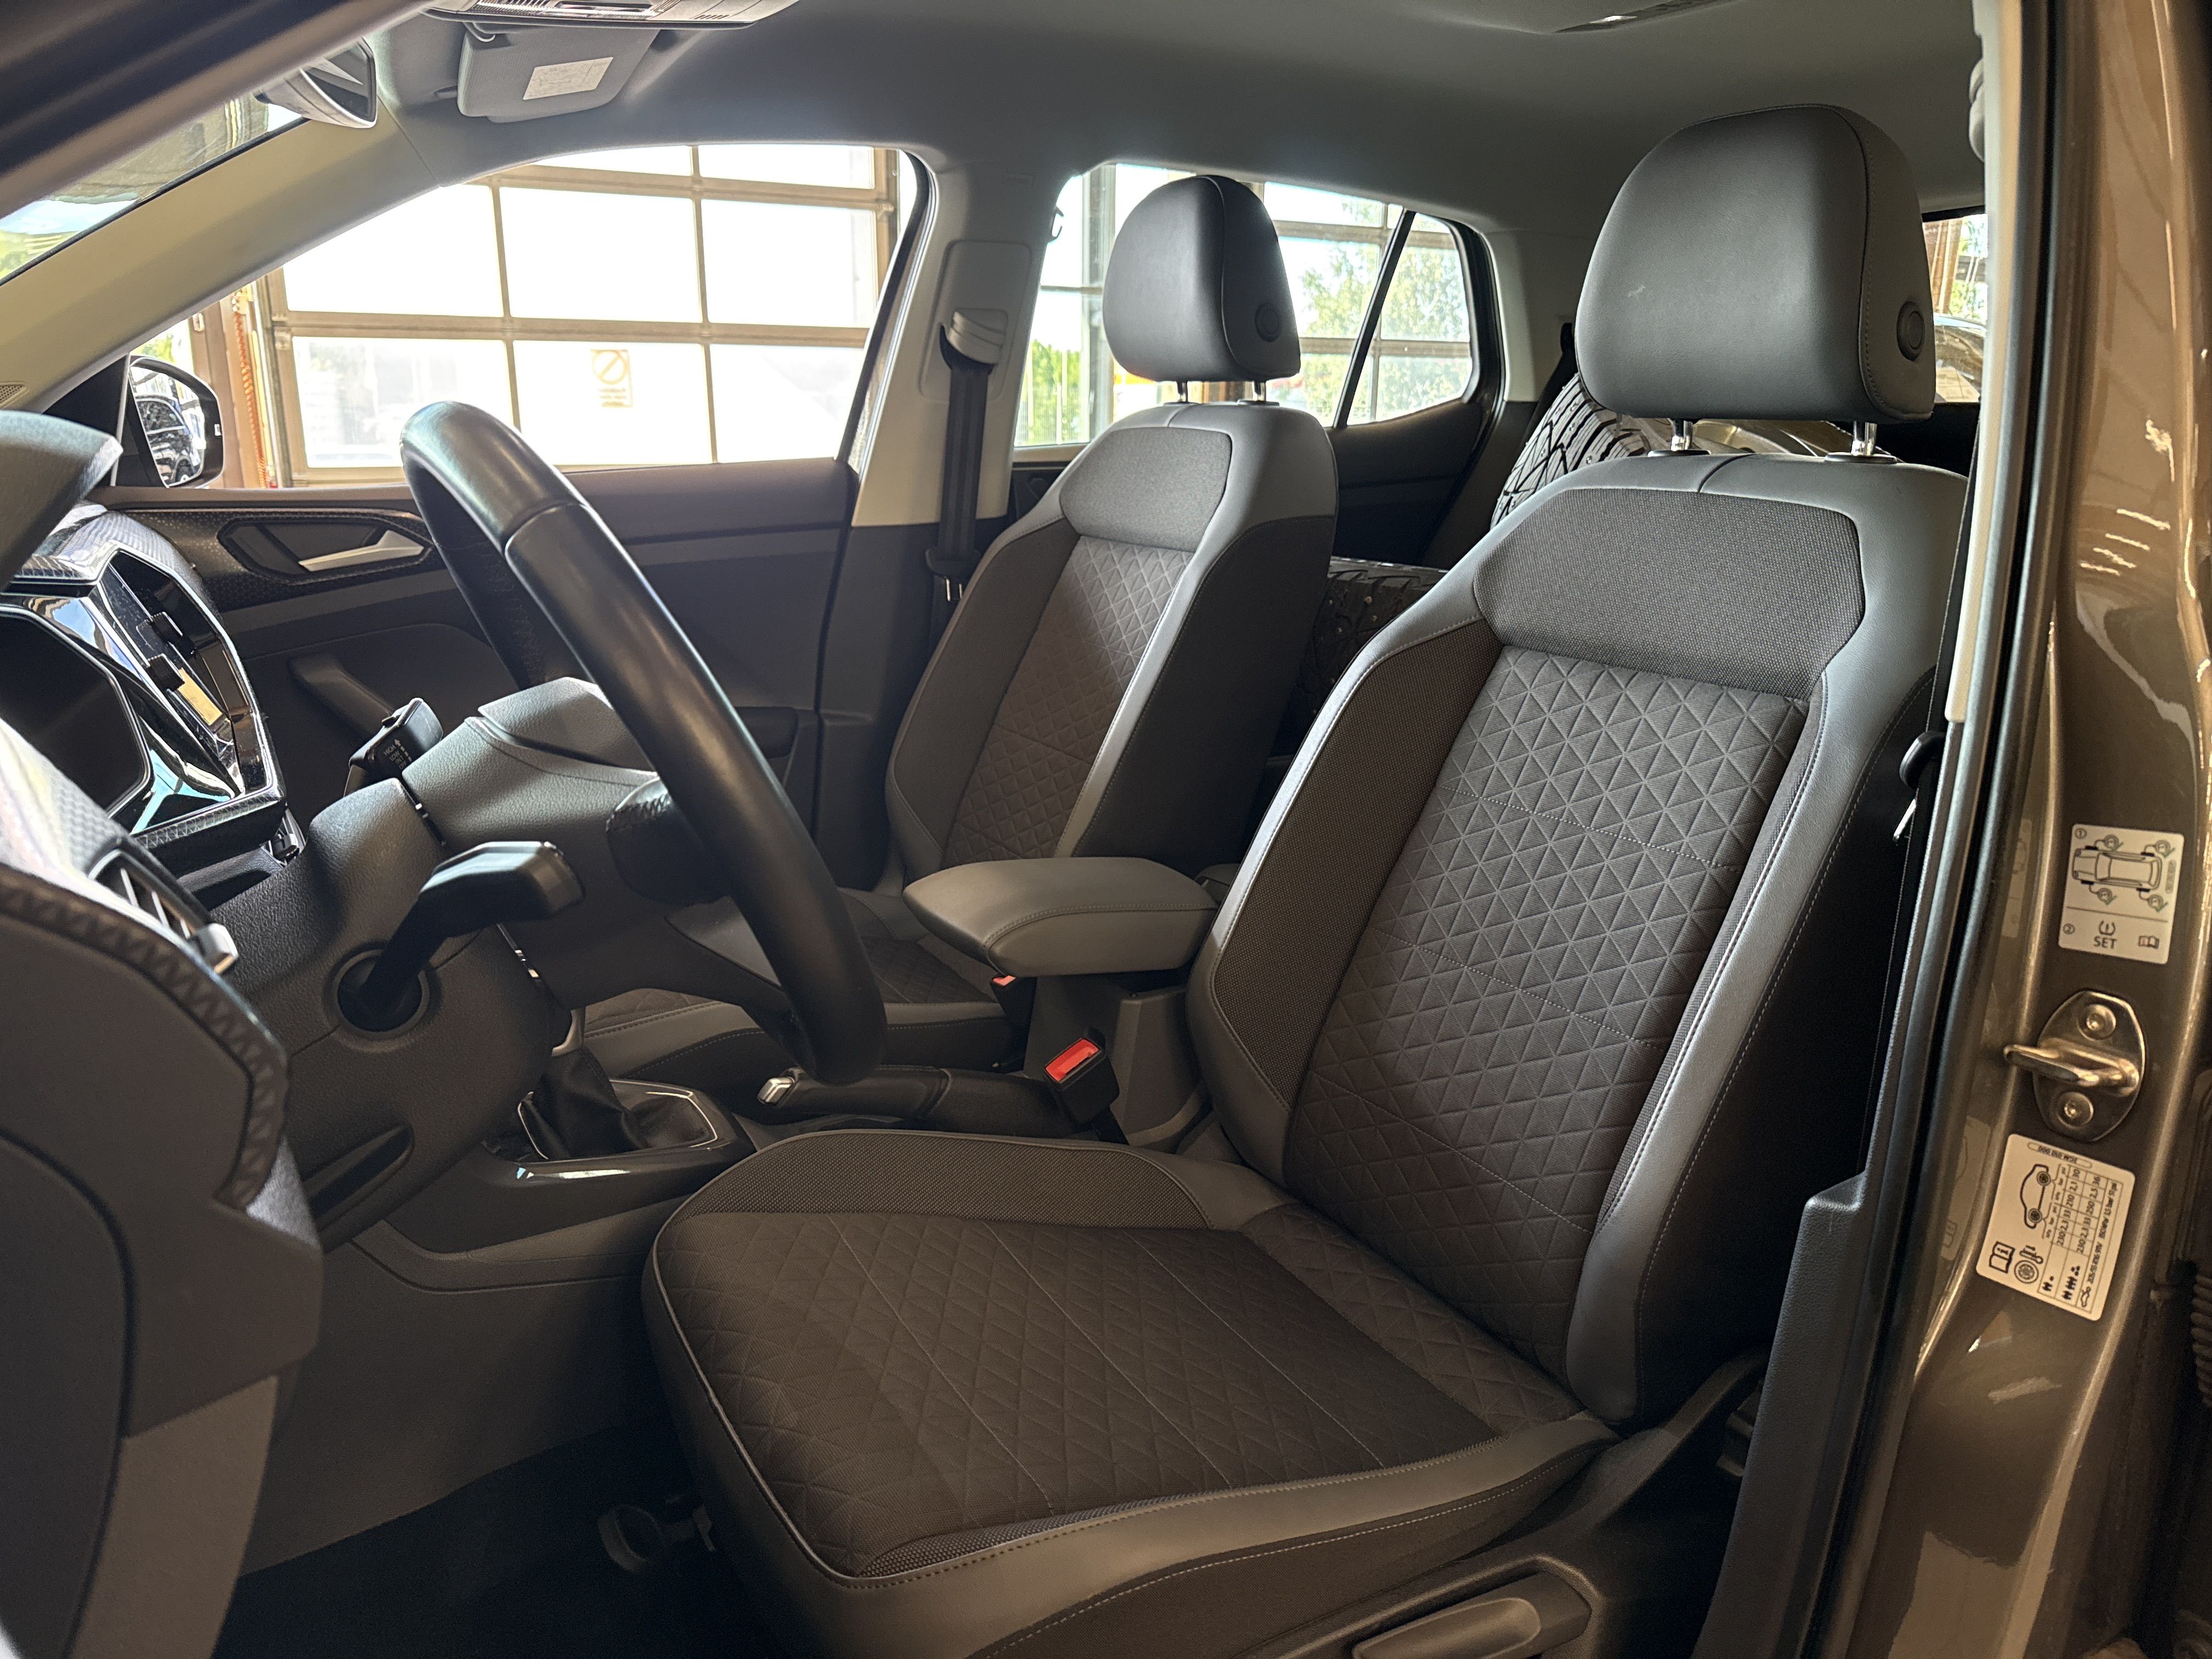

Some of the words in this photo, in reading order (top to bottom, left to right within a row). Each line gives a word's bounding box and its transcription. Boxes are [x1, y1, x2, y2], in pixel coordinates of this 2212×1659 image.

[383, 744, 396, 756] HIGH
[389, 750, 400, 761] LOW
[394, 755, 404, 764] INT
[2094, 935, 2117, 949] SET
[2072, 1169, 2080, 1178] 30
[2092, 1175, 2101, 1186] 36
[2089, 1187, 2098, 1199] 2,5
[2066, 1194, 2075, 1207] 210
[2085, 1200, 2095, 1214] 250
[2063, 1209, 2071, 1218] 33
[2060, 1219, 2069, 1231] 2,3
[2083, 1216, 2091, 1225] 33
[2057, 1231, 2066, 1245] 230
[2080, 1227, 2089, 1238] 2,3
[2076, 1238, 2086, 1252] 230
